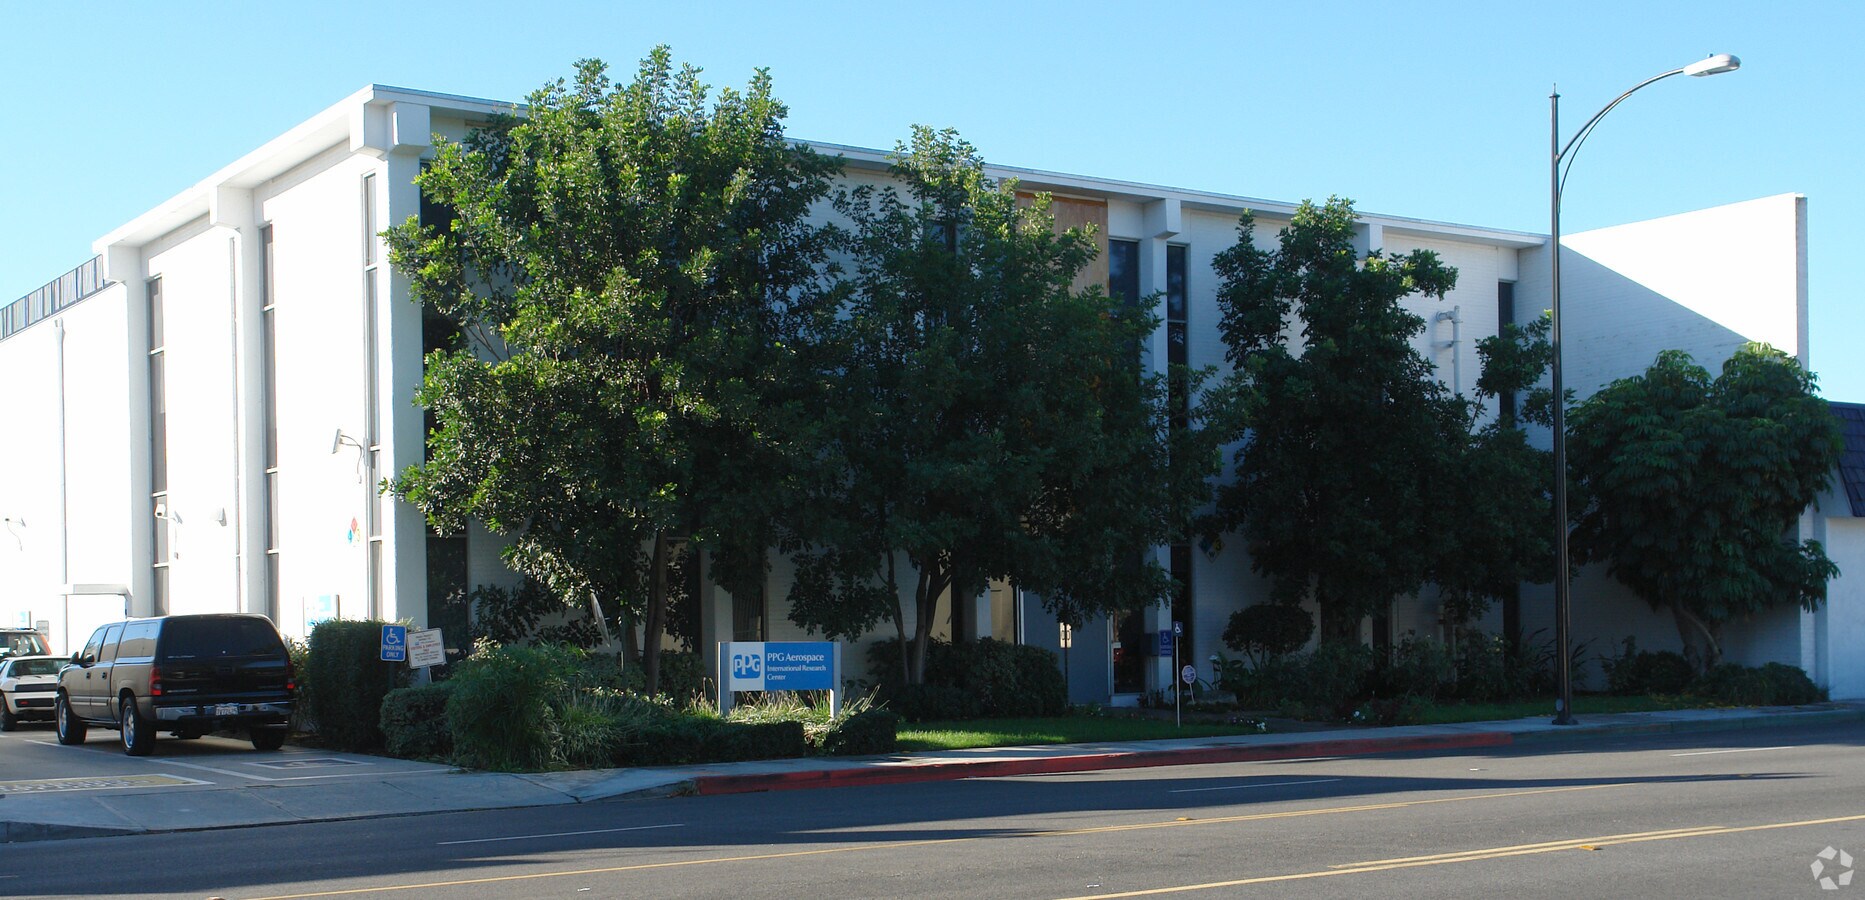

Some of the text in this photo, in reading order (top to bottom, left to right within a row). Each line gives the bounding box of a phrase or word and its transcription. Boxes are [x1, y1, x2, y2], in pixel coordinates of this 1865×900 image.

[734, 654, 760, 675] PPG
[767, 652, 824, 663] PPG Aerospace
